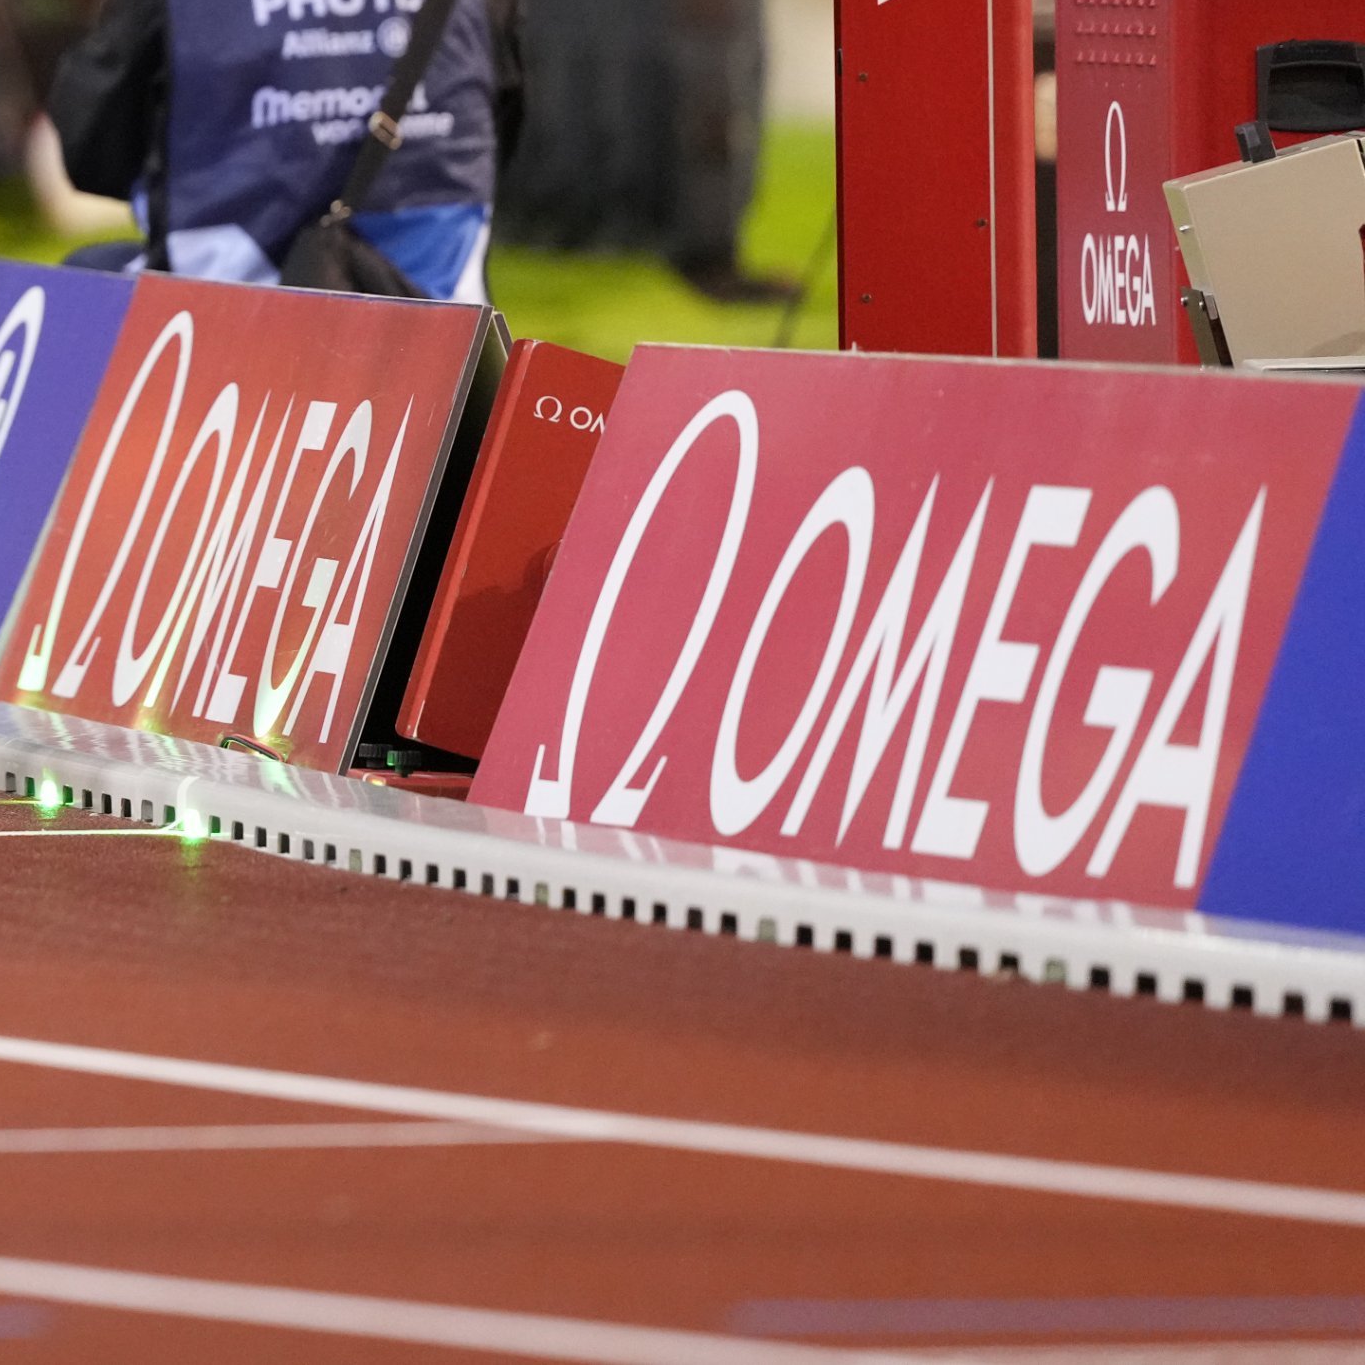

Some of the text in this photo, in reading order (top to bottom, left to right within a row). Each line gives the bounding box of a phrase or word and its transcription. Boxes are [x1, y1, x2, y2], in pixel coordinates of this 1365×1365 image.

[1080, 232, 1157, 327] OMEGA
[112, 382, 414, 745] OMEGA
[709, 465, 1267, 890] OMEGA
